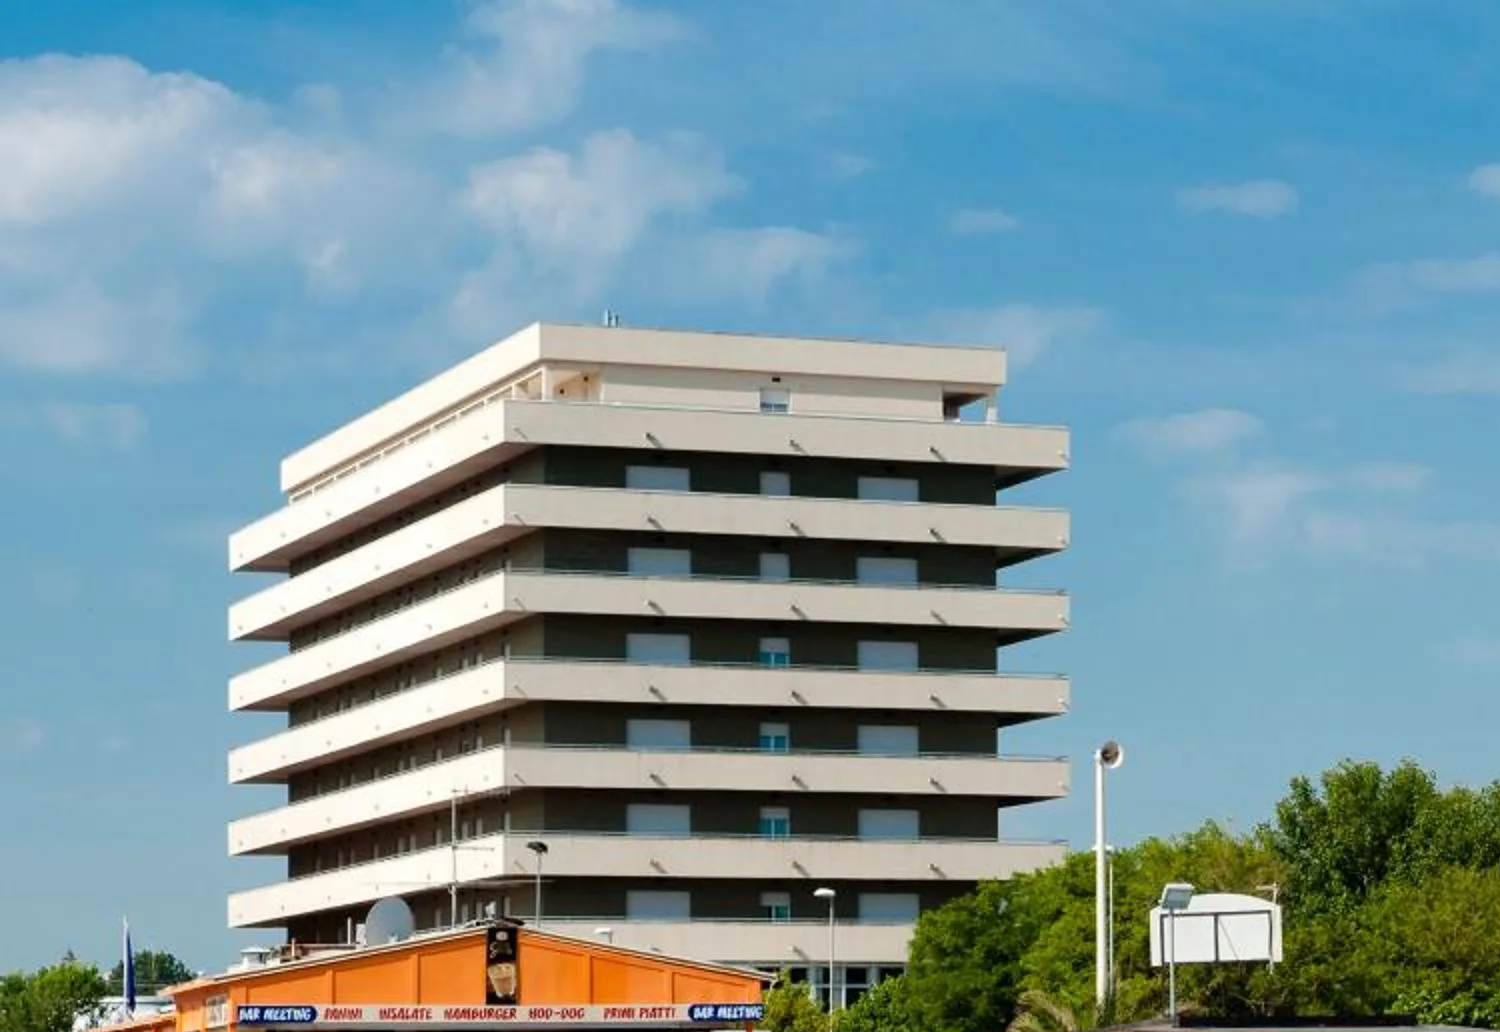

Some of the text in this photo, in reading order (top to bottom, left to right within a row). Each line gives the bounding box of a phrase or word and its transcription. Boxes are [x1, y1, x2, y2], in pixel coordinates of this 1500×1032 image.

[239, 1007, 312, 1021] BAR MEETING
[324, 1008, 363, 1020] PANINI
[379, 1008, 432, 1020] INSALATE
[444, 1008, 518, 1020] HAMBURGER
[603, 1007, 676, 1019] PRIMI PIATTI
[692, 1006, 763, 1019] BAR MEETING
